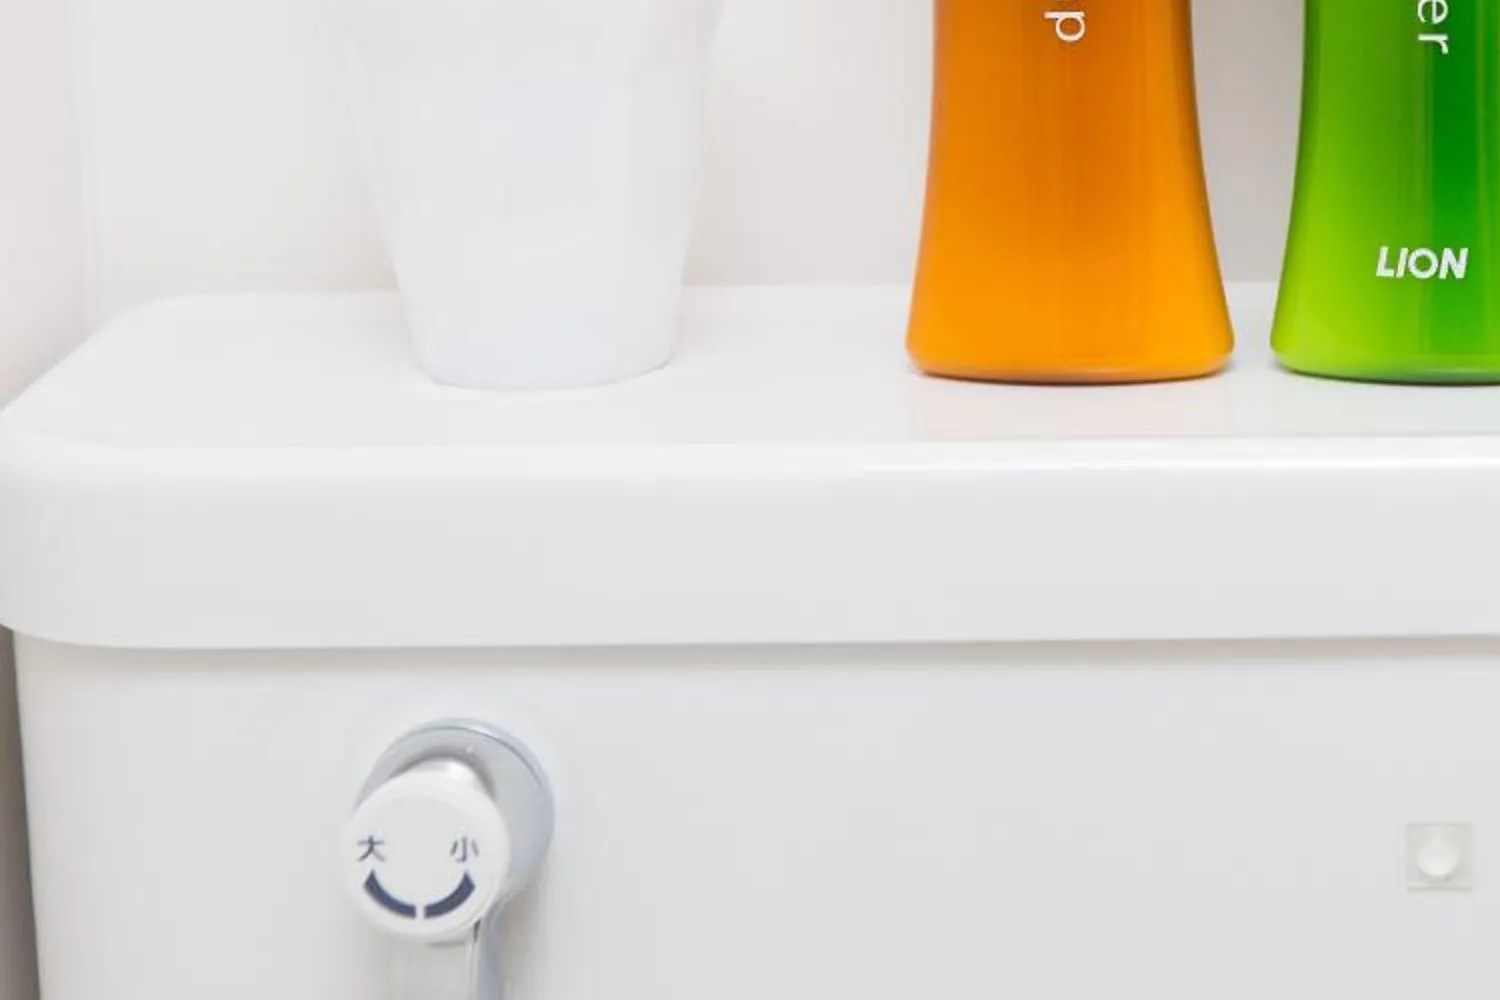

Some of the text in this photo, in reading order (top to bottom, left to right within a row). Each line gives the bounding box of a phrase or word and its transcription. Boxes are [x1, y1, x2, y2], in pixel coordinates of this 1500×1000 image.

[1376, 246, 1469, 279] LION
[357, 834, 479, 863] 大 小
